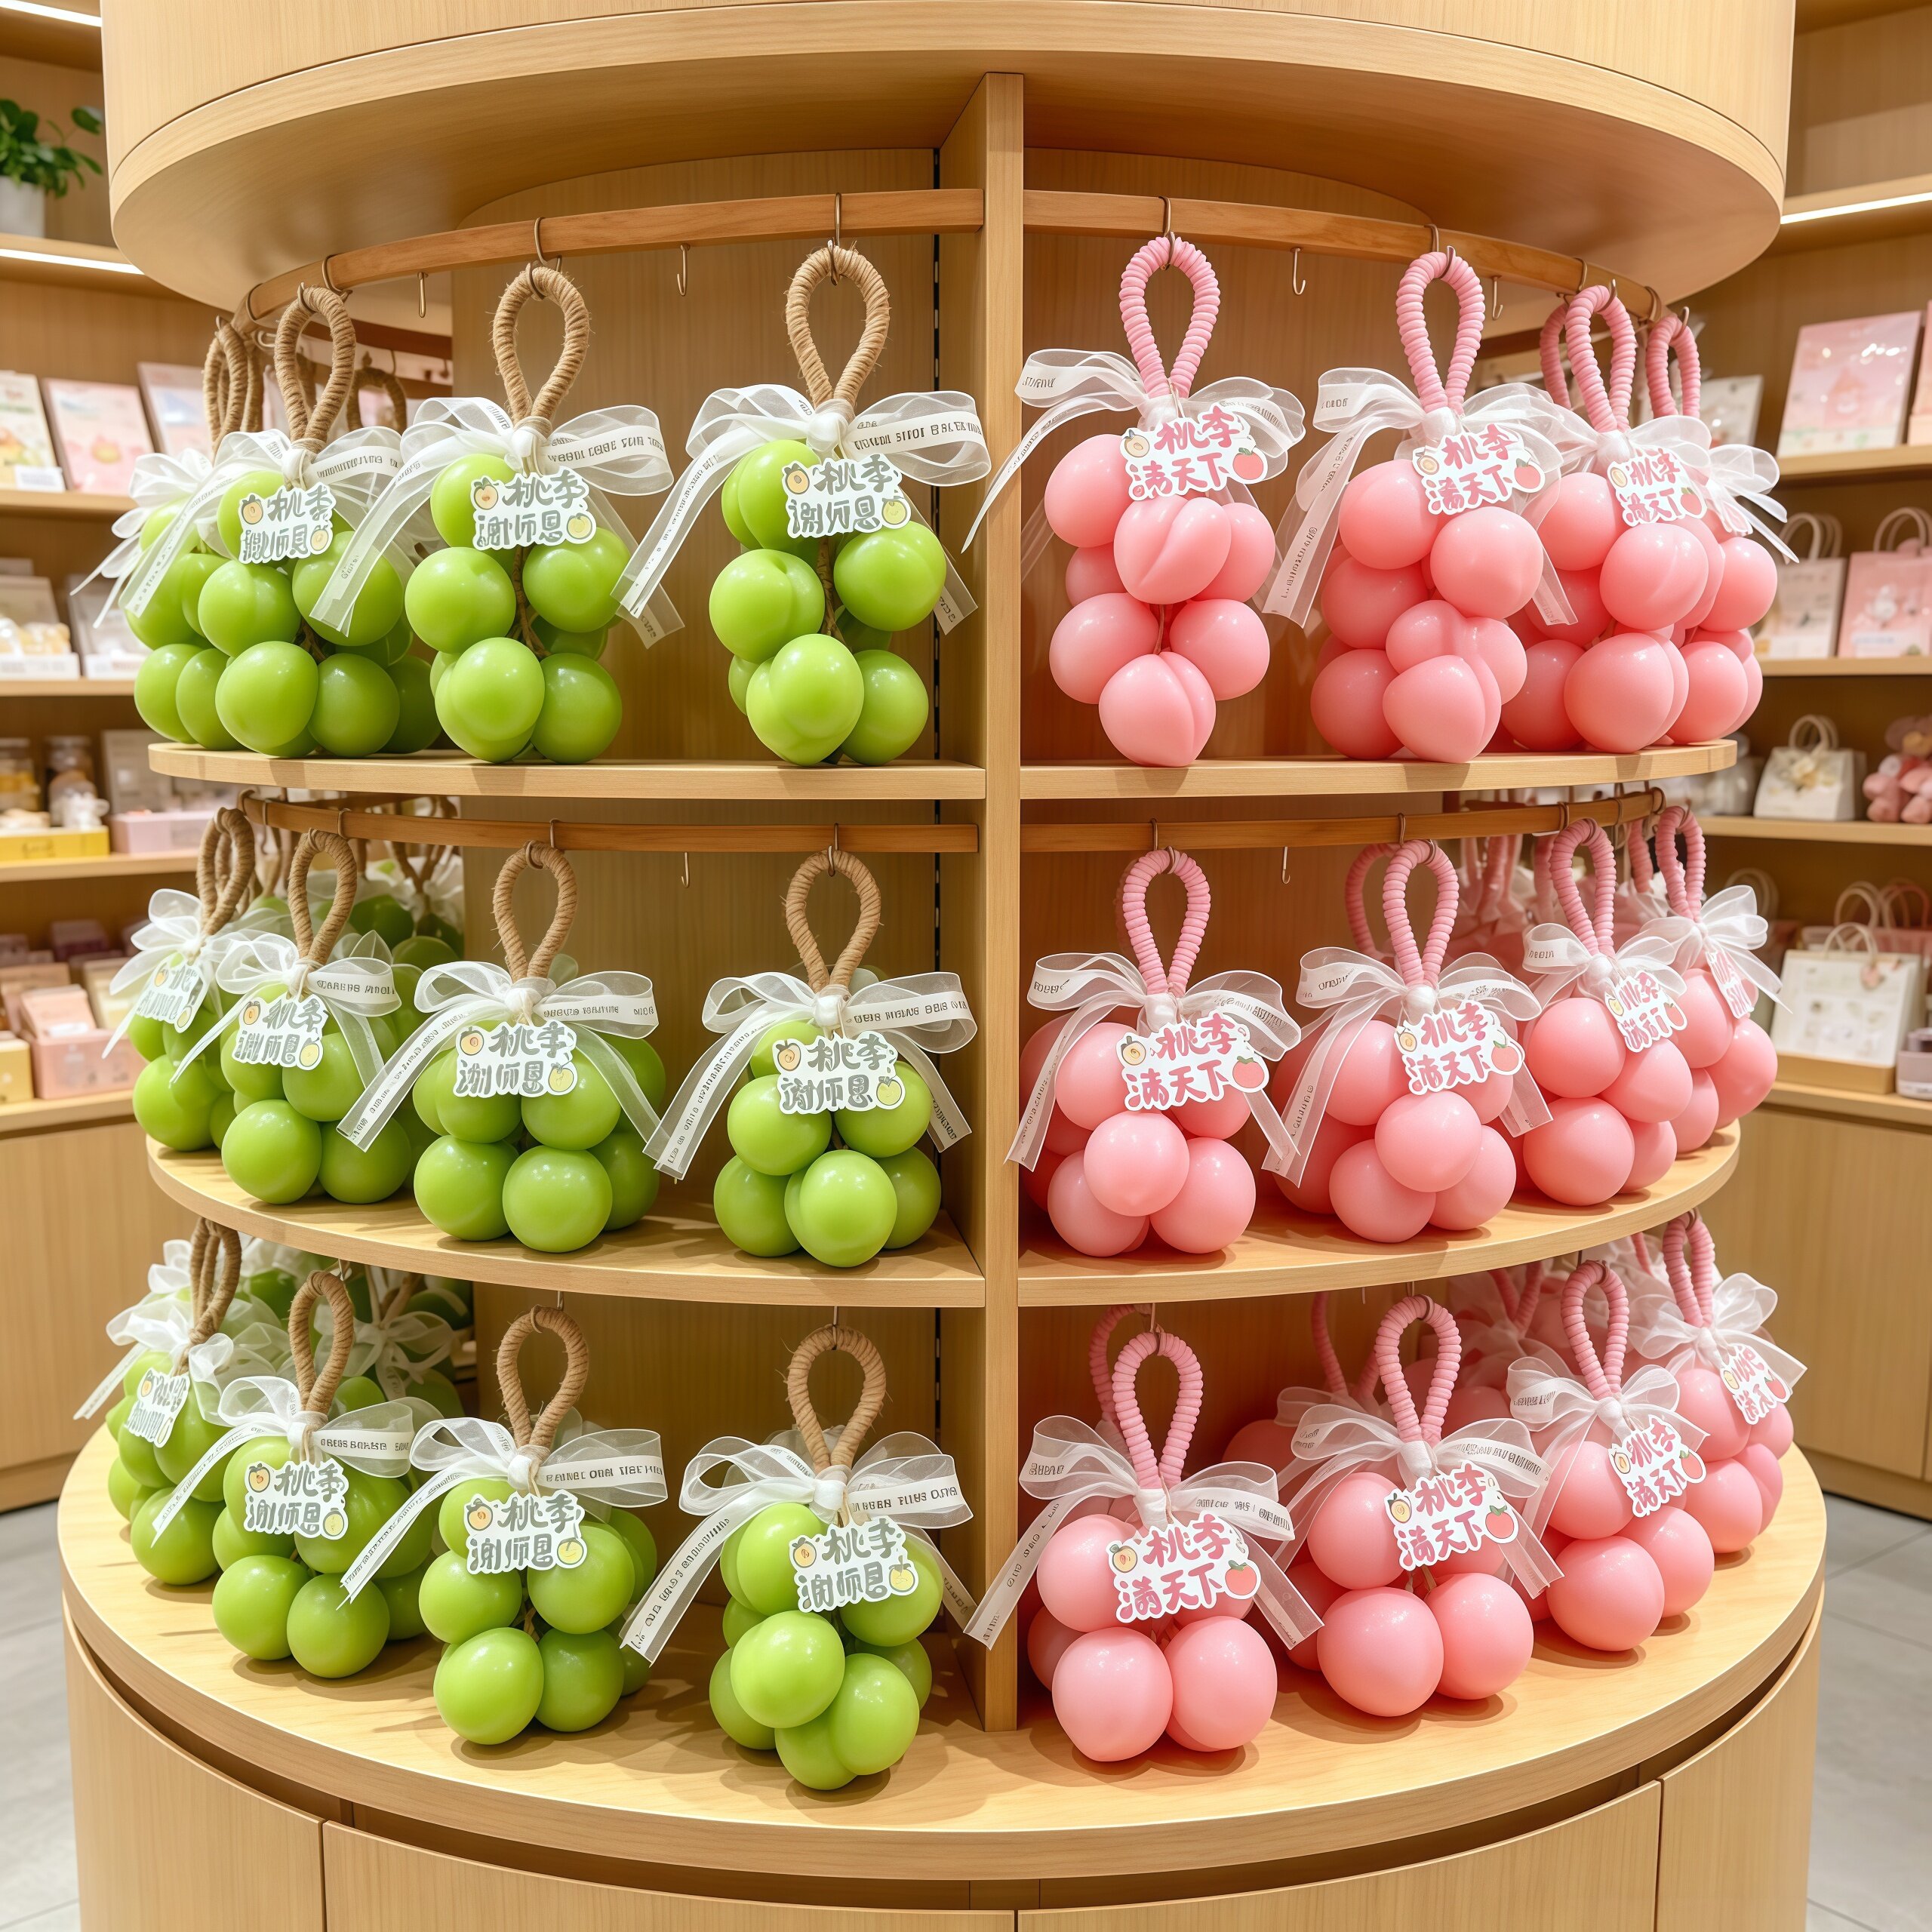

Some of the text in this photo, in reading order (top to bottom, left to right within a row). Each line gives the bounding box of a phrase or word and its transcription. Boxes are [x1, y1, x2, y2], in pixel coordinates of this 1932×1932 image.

[1154, 405, 1240, 454] 桃李
[1130, 452, 1229, 499] 满天下
[1426, 464, 1512, 511] 满天下
[1126, 1060, 1229, 1107] 满天下
[1415, 1463, 1486, 1516] 桃李
[1143, 1514, 1230, 1567] 桃李
[1398, 1510, 1482, 1566] 满天下
[1120, 1562, 1223, 1619] 满天下
